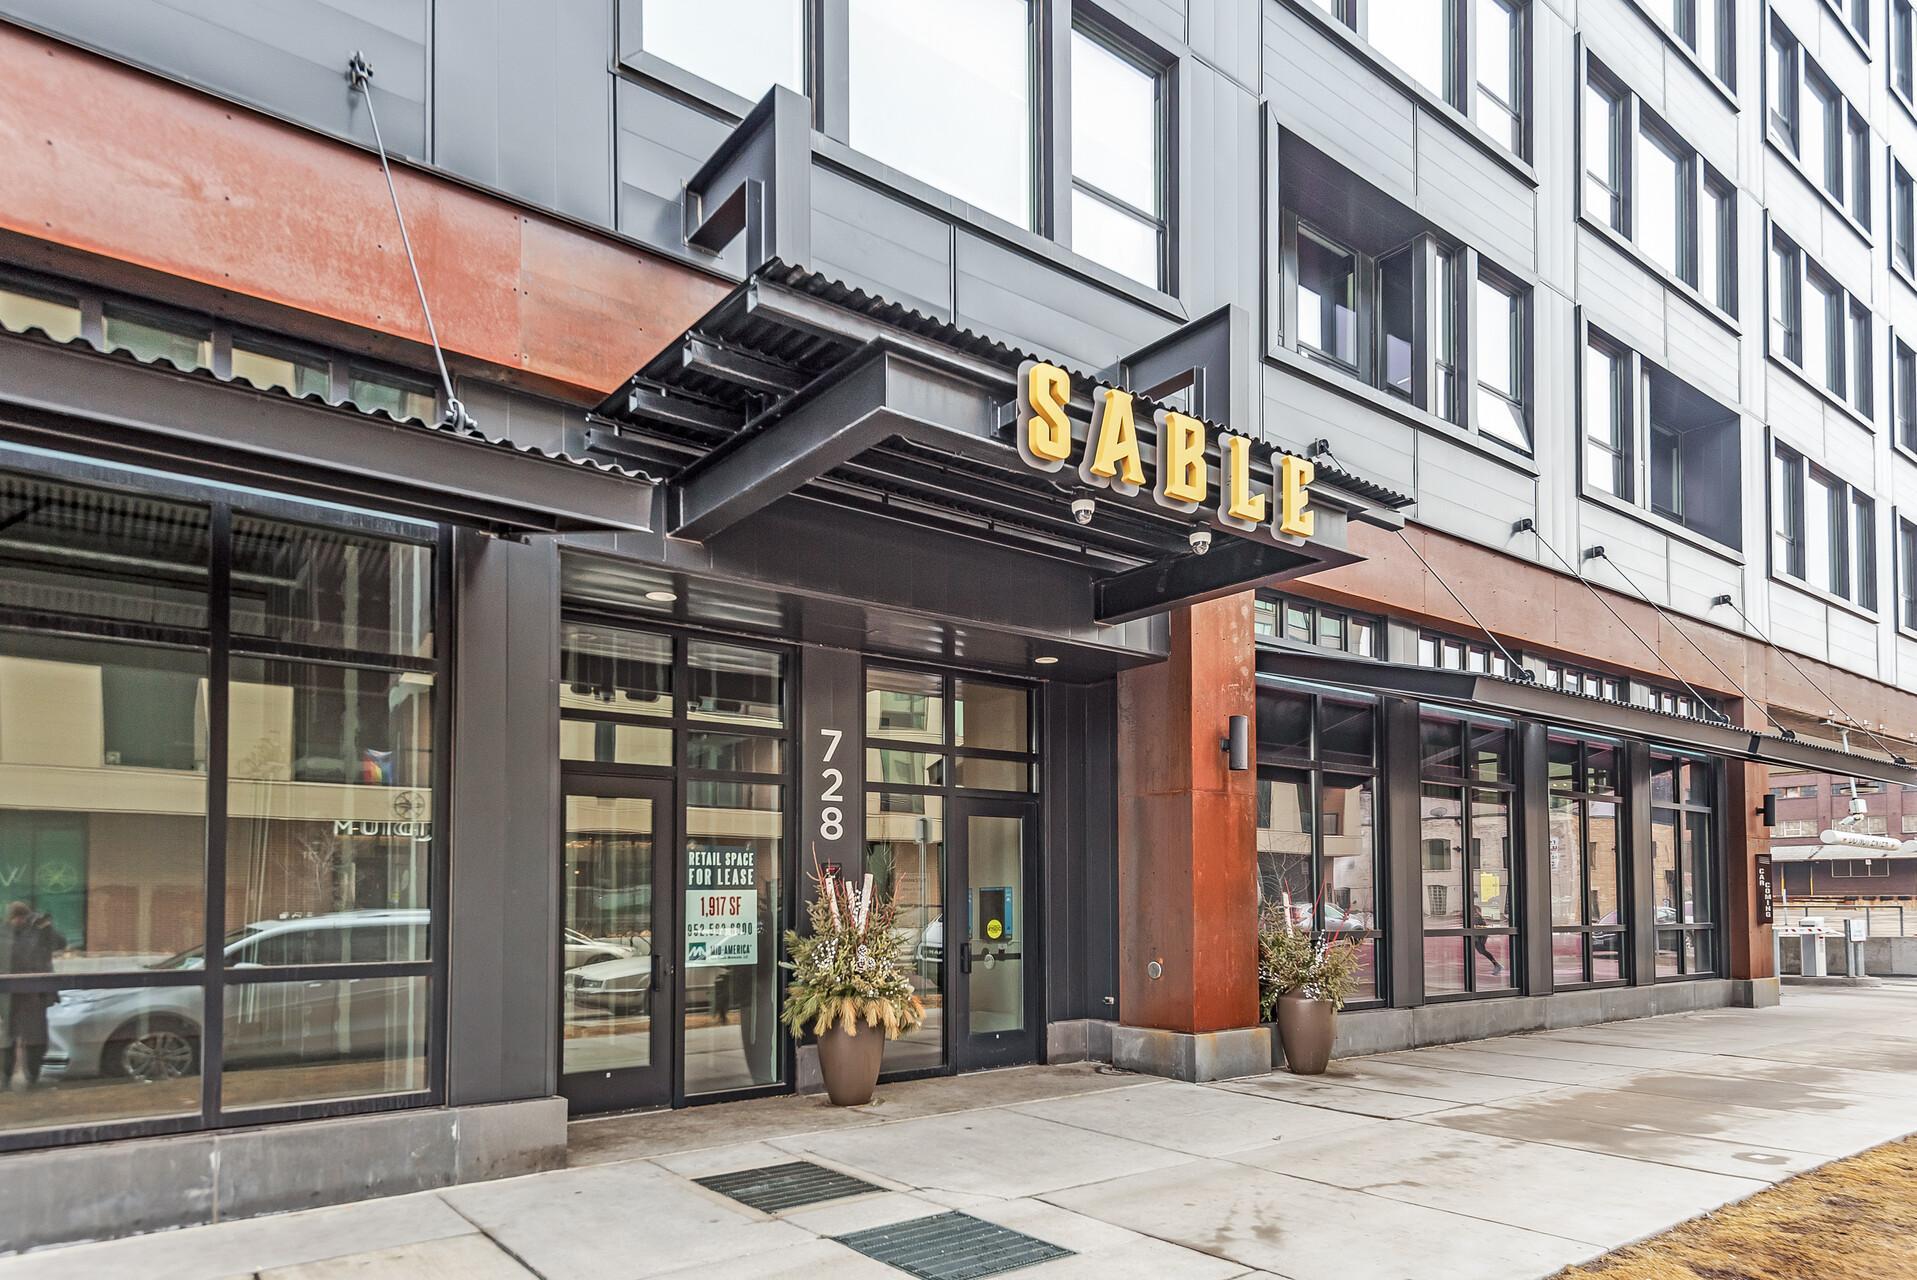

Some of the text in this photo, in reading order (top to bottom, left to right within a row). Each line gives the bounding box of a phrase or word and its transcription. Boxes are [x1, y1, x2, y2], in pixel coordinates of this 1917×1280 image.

[1025, 361, 1315, 539] SABLE
[820, 729, 843, 840] 728
[688, 852, 754, 866] RETAIL SPACE
[688, 868, 754, 885] FOR LEASE
[700, 896, 742, 917] 1,917 SF
